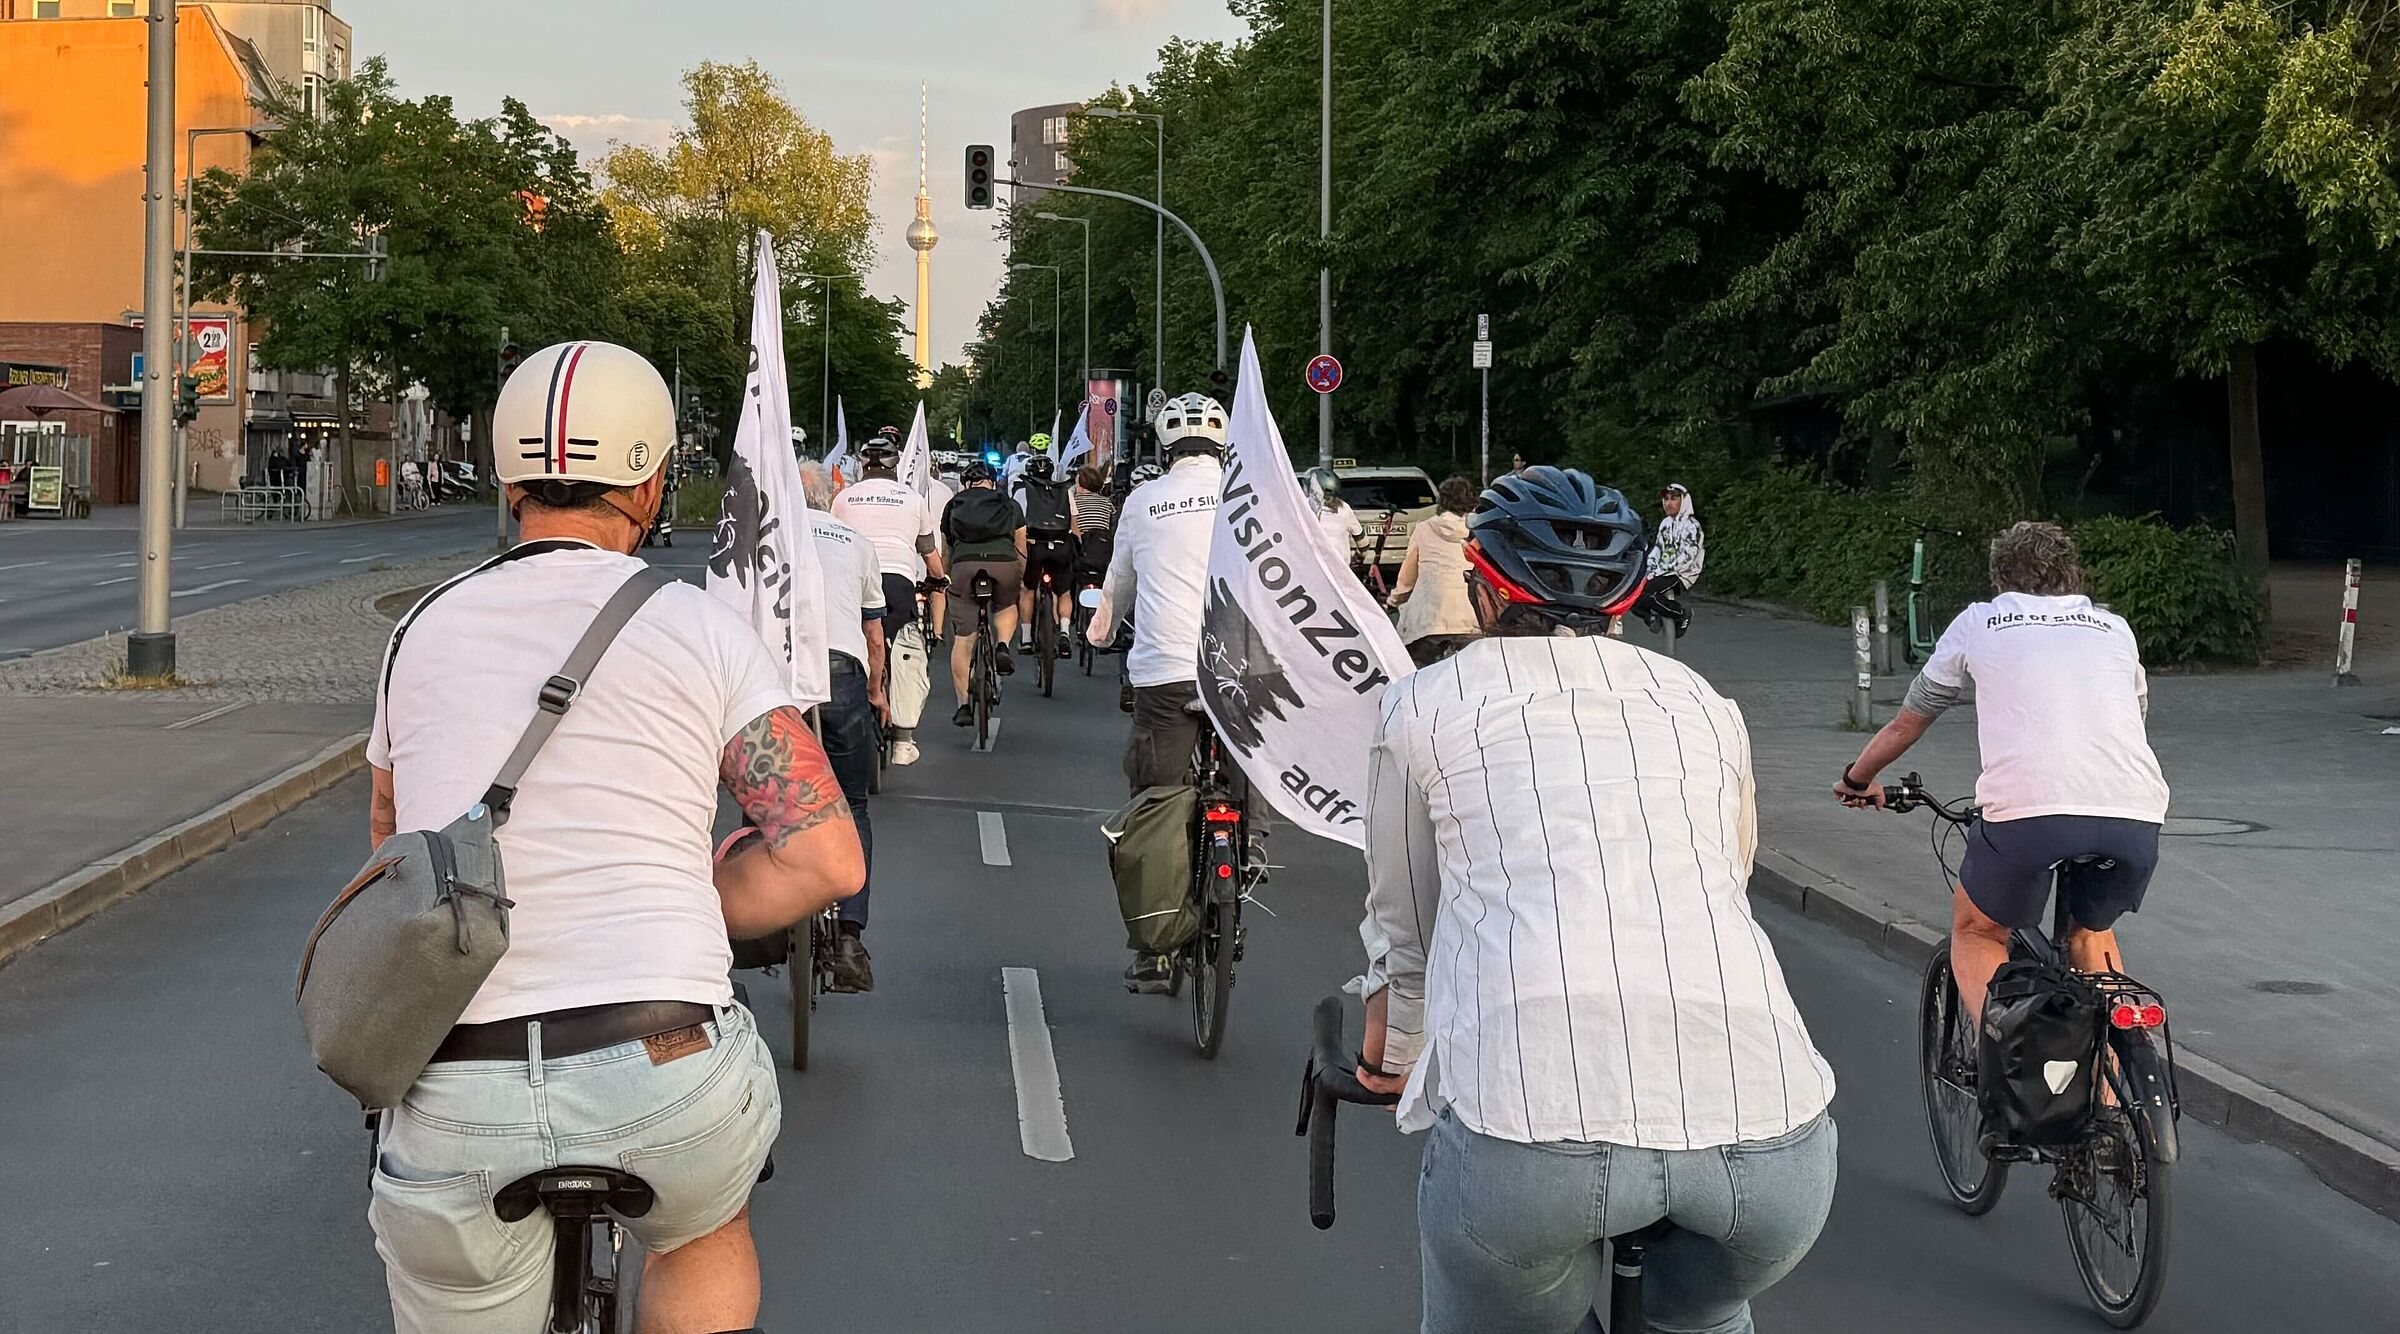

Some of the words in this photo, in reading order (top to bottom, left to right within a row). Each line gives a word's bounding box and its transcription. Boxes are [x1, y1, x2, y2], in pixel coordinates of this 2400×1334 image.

[1149, 501, 1176, 517] Ride
[1180, 497, 1194, 508] of
[1987, 613, 2024, 629] Ride
